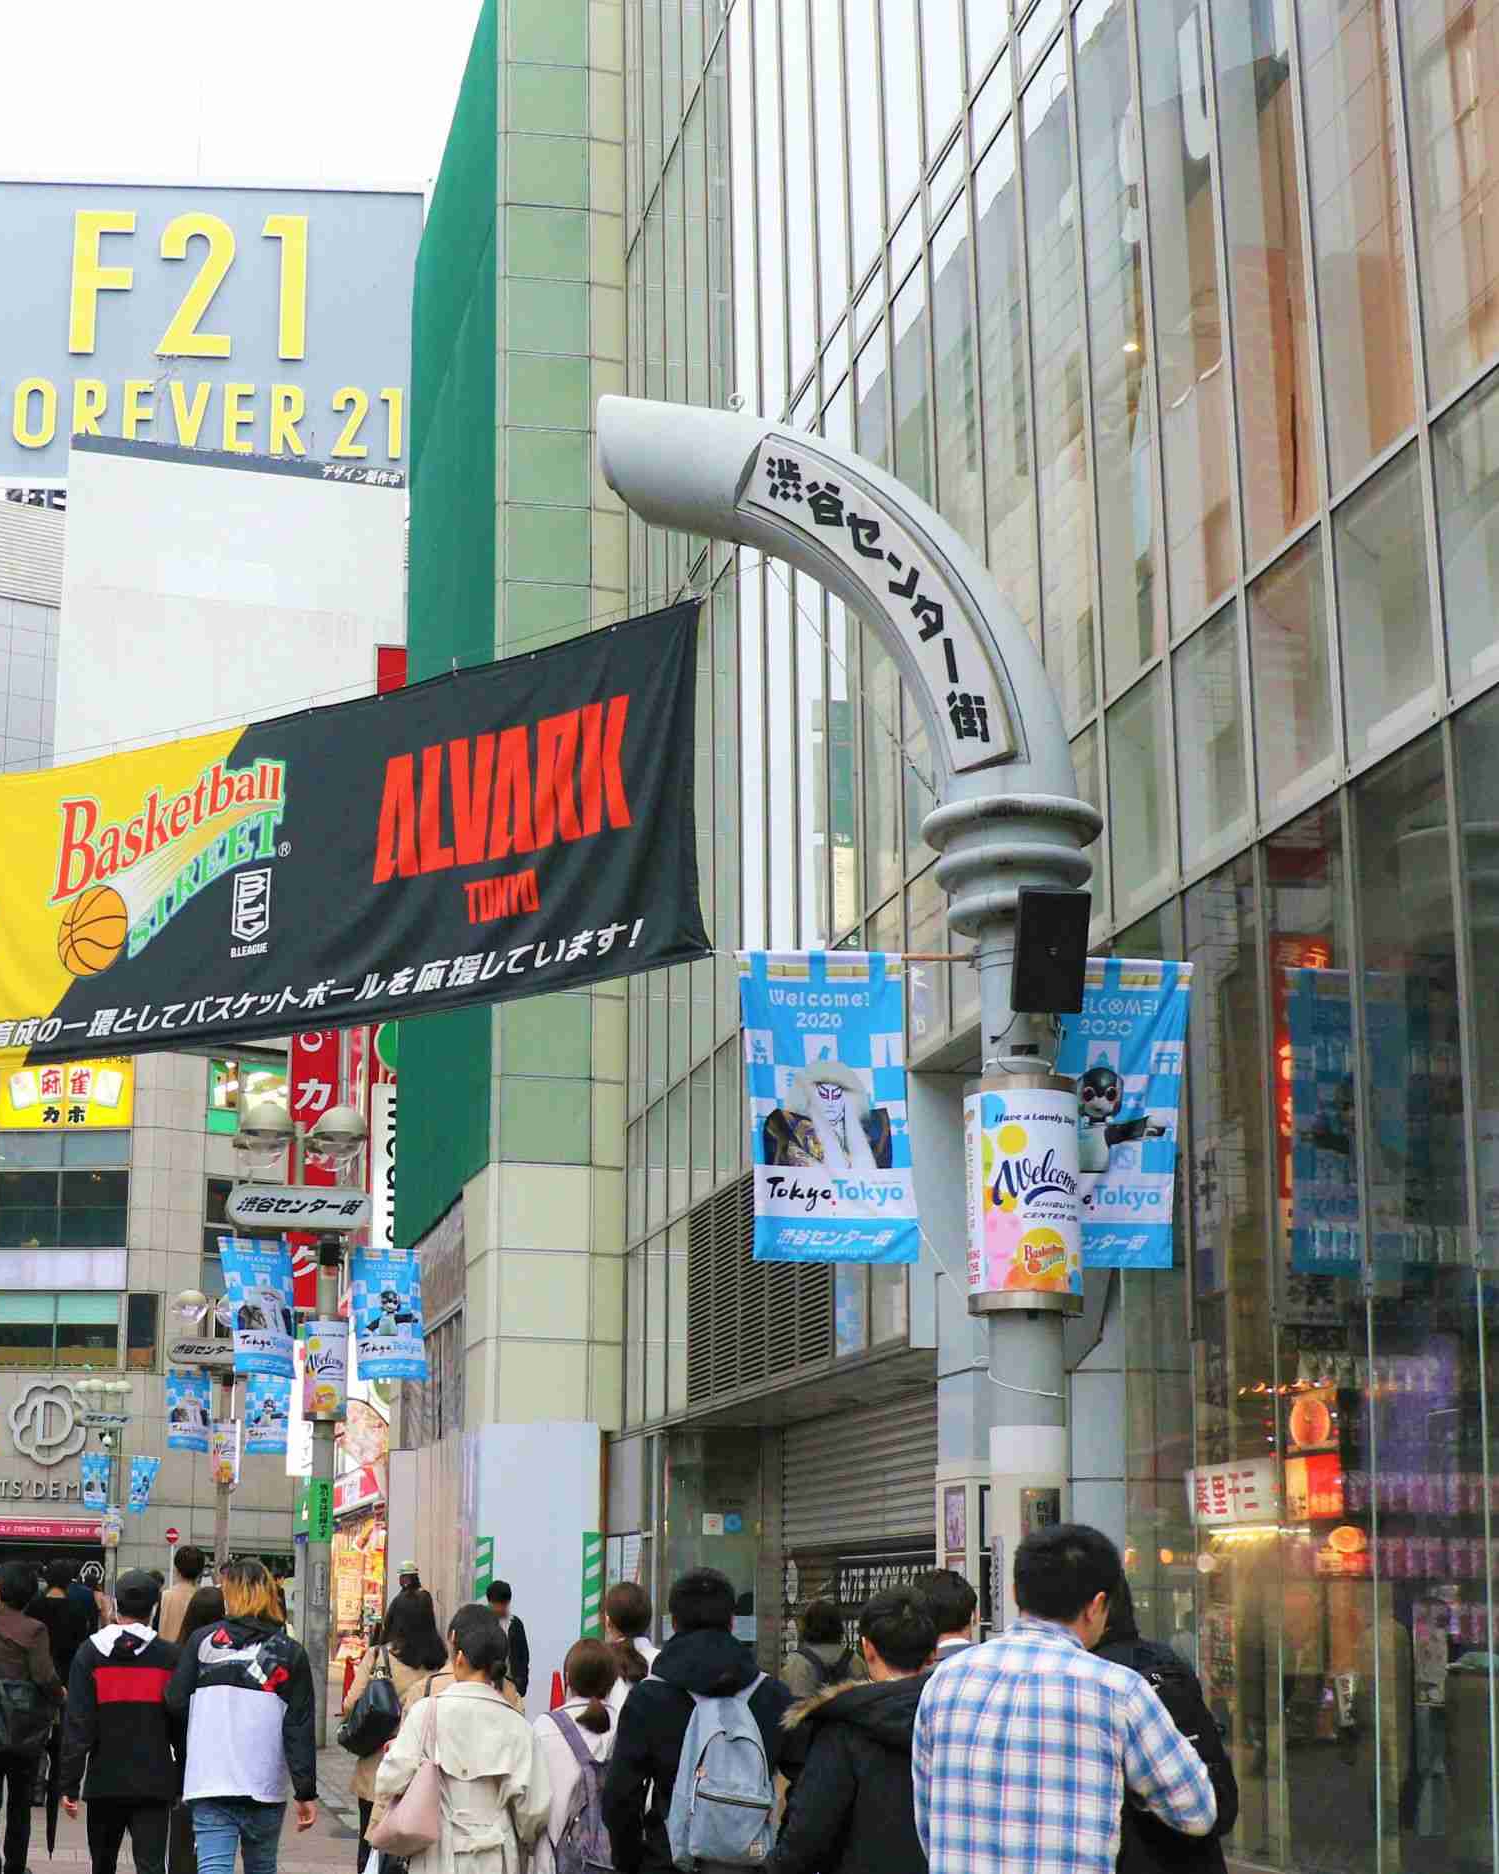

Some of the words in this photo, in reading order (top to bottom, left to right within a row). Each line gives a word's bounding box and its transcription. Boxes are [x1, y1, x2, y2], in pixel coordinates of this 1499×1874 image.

[69, 210, 309, 361] F21
[331, 386, 404, 460] 21
[765, 457, 991, 743] 渋谷センター街
[372, 694, 633, 885] ALVARK
[50, 761, 284, 903] Basketball
[463, 869, 541, 925] TOKYO
[768, 988, 870, 1007] Welcome!
[796, 1011, 844, 1029] 2020
[1078, 1018, 1134, 1036] 2020
[41, 1068, 91, 1096] 麻雀
[1032, 1113, 1063, 1124] Lovely
[766, 1176, 832, 1212] Tokyo
[832, 1180, 903, 1212] Tokyo
[992, 1148, 1077, 1206] Welcome
[236, 1196, 364, 1217] 渋谷センター街
[1094, 1185, 1161, 1211] Tokyo
